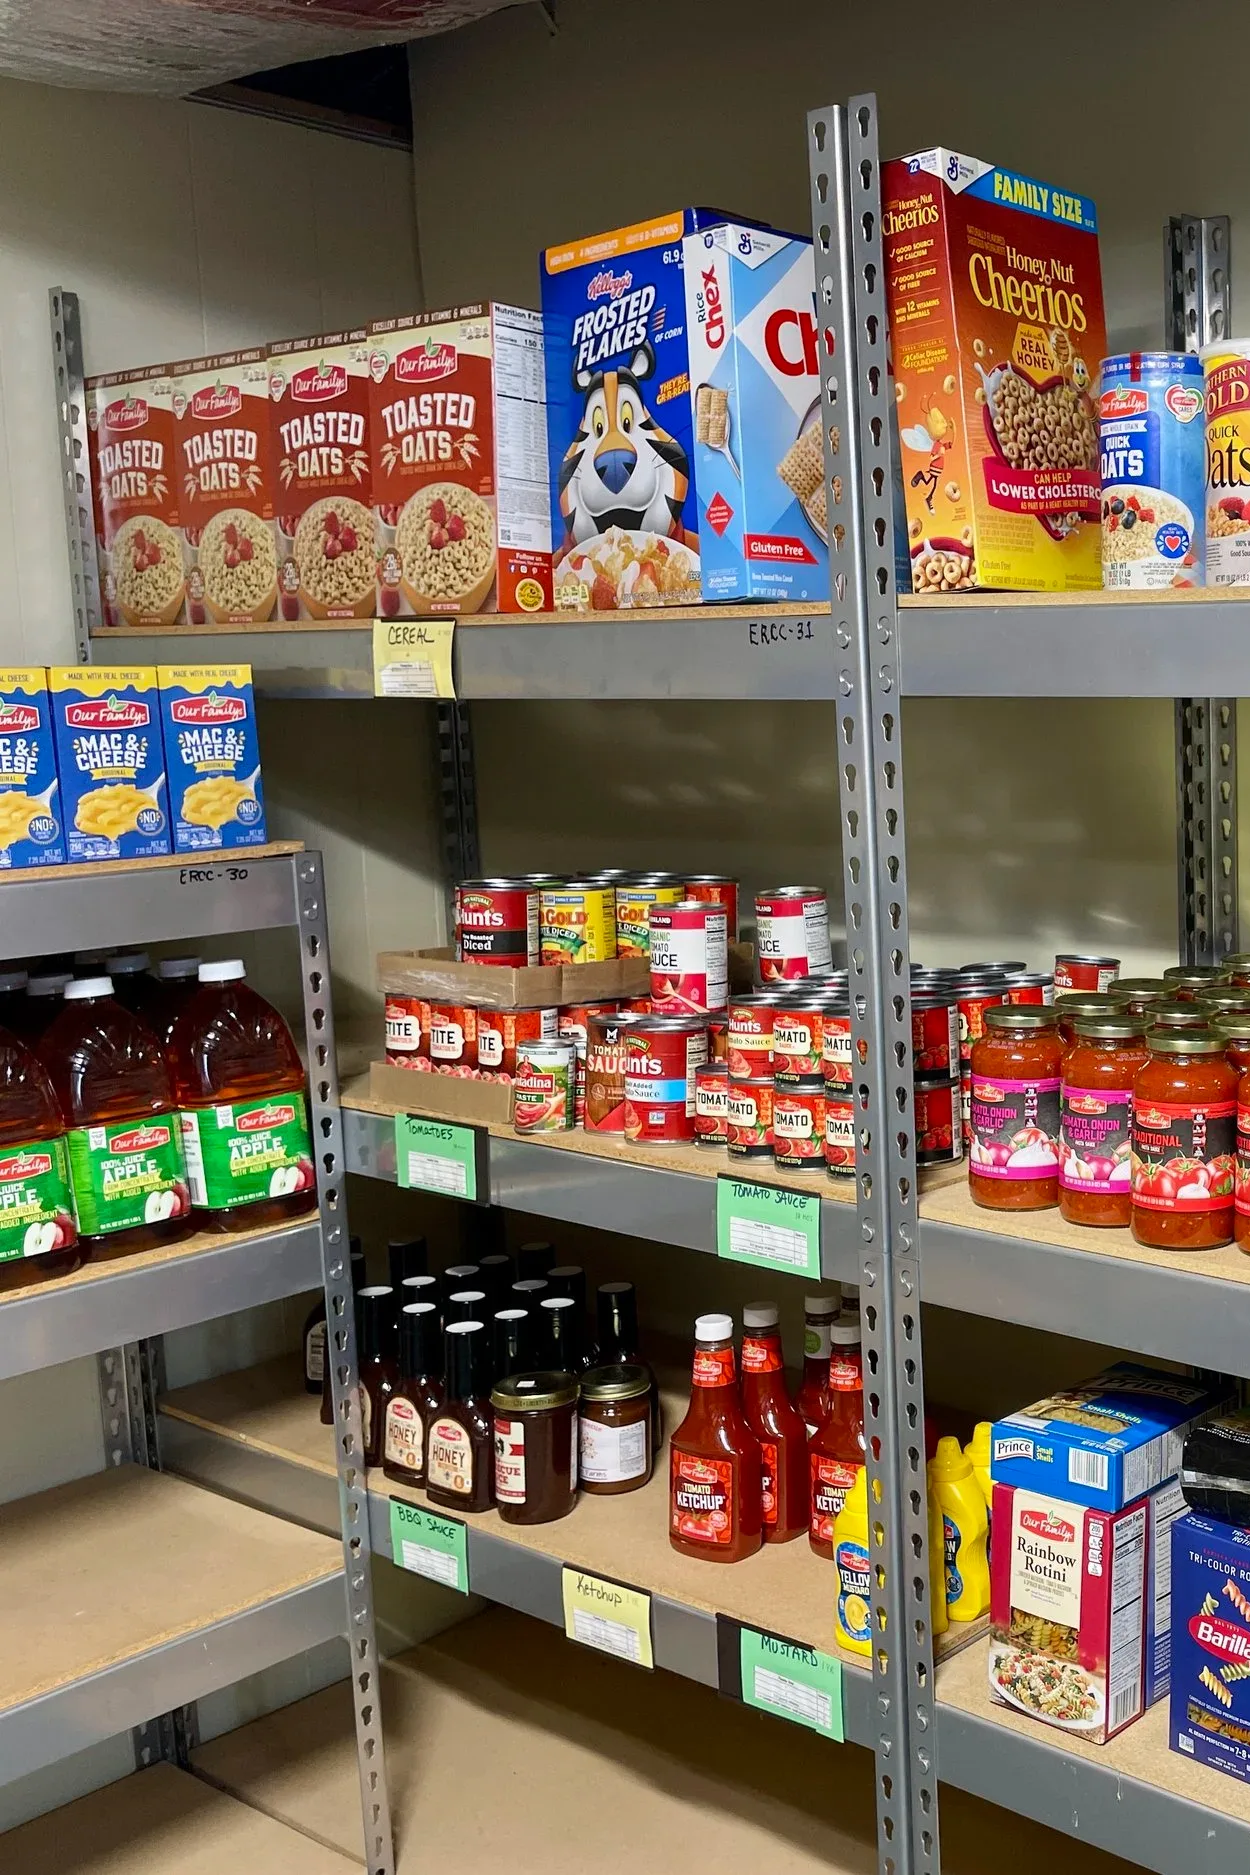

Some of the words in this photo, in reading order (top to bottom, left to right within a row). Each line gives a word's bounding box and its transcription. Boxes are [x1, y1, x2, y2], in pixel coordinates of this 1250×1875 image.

[994, 172, 1048, 212] FAMILY
[1052, 191, 1082, 223] SIZE
[881, 204, 939, 236] Cheerios
[1005, 246, 1047, 282] Honey
[1050, 259, 1075, 284] Nut
[587, 270, 633, 300] Kellogg's
[968, 253, 1086, 333] Cheerios
[572, 285, 656, 346] FROSTED
[696, 292, 705, 323] Rice
[702, 264, 724, 349] Chex
[577, 315, 648, 371] FLAKES
[654, 333, 664, 343] OF
[664, 326, 683, 340] CORN
[1021, 337, 1048, 356] REAL
[1017, 353, 1055, 372] HONEY
[381, 393, 475, 438] TOASTED
[280, 411, 364, 448] TOASTED
[1209, 425, 1239, 440] QUICK
[183, 429, 257, 462] TOASTED
[401, 430, 453, 463] OATS
[1105, 436, 1131, 449] QUICK
[98, 440, 163, 471] TOASTED
[298, 447, 343, 478] OATS
[111, 471, 147, 499] OATS
[200, 462, 240, 491] OATS
[1034, 473, 1051, 483] CAN
[1052, 473, 1071, 483] HELP
[992, 480, 1036, 500] LOWER
[1038, 485, 1101, 500] CHOLESTERO
[751, 541, 781, 554] Gluten
[784, 544, 804, 556] Free
[388, 625, 434, 645] CEREAL
[73, 709, 98, 722] Our
[100, 706, 142, 725] Family
[177, 704, 198, 718] Our
[202, 702, 239, 720] Family
[81, 734, 121, 751] MAC
[126, 734, 139, 750] &
[185, 729, 221, 746] MAC
[225, 729, 237, 744] &
[76, 751, 146, 770] CHEESE
[182, 744, 244, 763] CHEESE
[143, 812, 156, 824] NO
[243, 803, 254, 814] NO
[546, 908, 588, 925] GOLD
[551, 928, 577, 939] DICED
[623, 923, 648, 935] DICED
[463, 939, 492, 951] Diced
[729, 1018, 761, 1033] Hunt's
[745, 1036, 770, 1045] Sauce
[240, 1118, 258, 1129] Our
[260, 1110, 291, 1128] Family
[114, 1139, 132, 1150] Our
[134, 1130, 166, 1149] Family
[228, 1136, 247, 1148] 100%
[249, 1132, 271, 1142] JUICE
[230, 1136, 283, 1160] APPLE
[101, 1158, 120, 1169] 100%
[122, 1154, 145, 1165] JUICE
[103, 1160, 158, 1185] APPLE
[732, 1184, 770, 1199] TOMATO
[775, 1191, 809, 1208] SAUCE
[1084, 1404, 1113, 1415] Small
[1112, 1411, 1143, 1425] Shells
[389, 1425, 416, 1443] HONEY
[433, 1445, 465, 1467] HONEY
[997, 1442, 1031, 1454] Prince
[684, 1483, 710, 1493] TOMATO
[677, 1492, 723, 1510] KETCHUP
[397, 1506, 422, 1525] BBQ
[426, 1517, 456, 1539] SAUCE
[1022, 1515, 1038, 1527] Our
[1040, 1520, 1073, 1542] Family
[1017, 1536, 1077, 1567] Rainbow
[1025, 1556, 1066, 1582] Rotini
[1189, 1551, 1236, 1576] TRI-COLOR
[577, 1575, 622, 1607] Ketchup
[761, 1635, 818, 1667] MUSTARD
